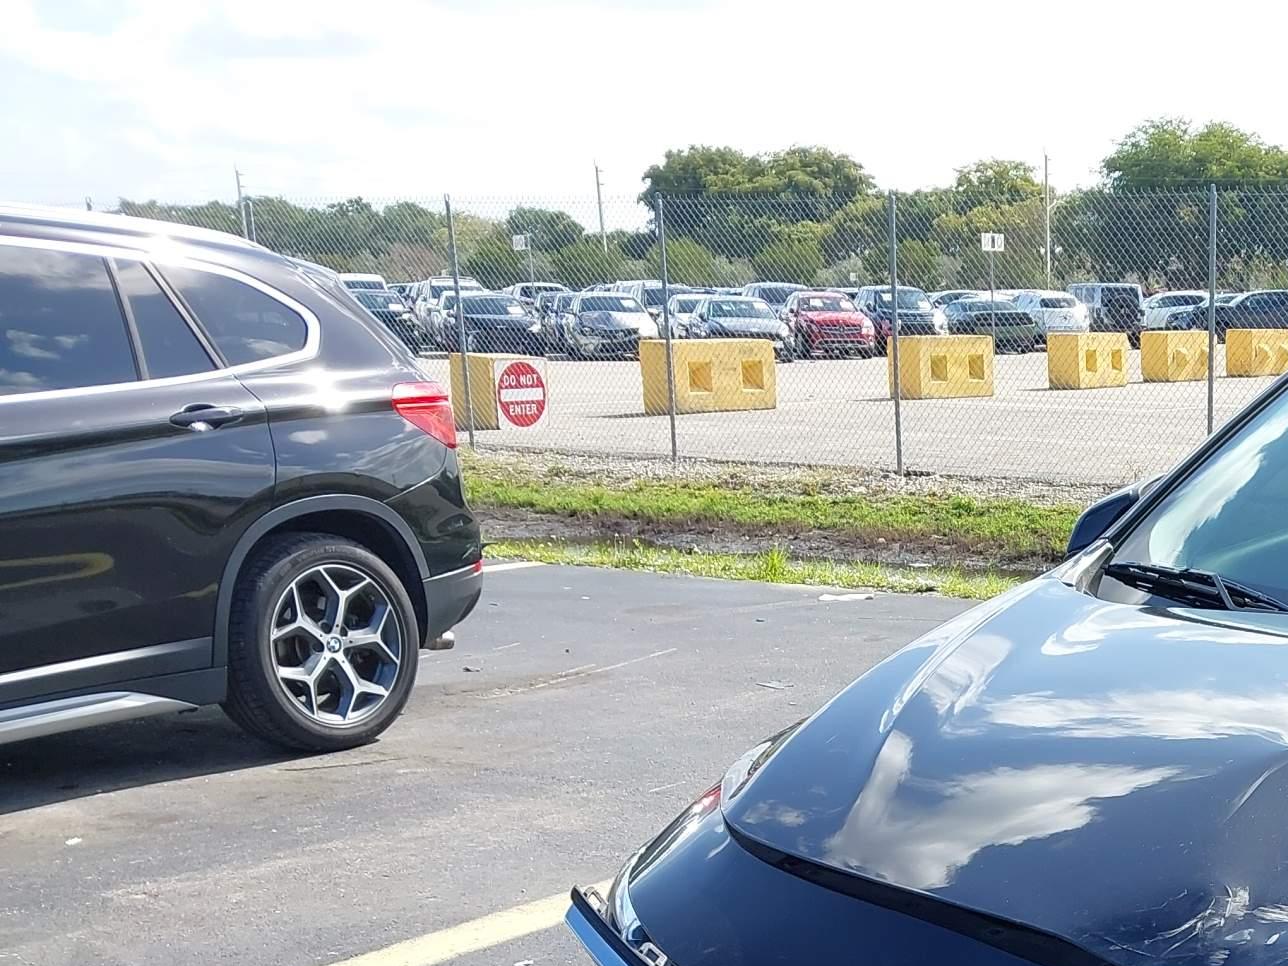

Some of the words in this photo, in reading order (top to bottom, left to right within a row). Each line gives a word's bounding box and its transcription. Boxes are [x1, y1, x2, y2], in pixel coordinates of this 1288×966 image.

[503, 375, 516, 386] DO
[519, 374, 538, 386] NOT
[509, 403, 538, 416] ENTER
